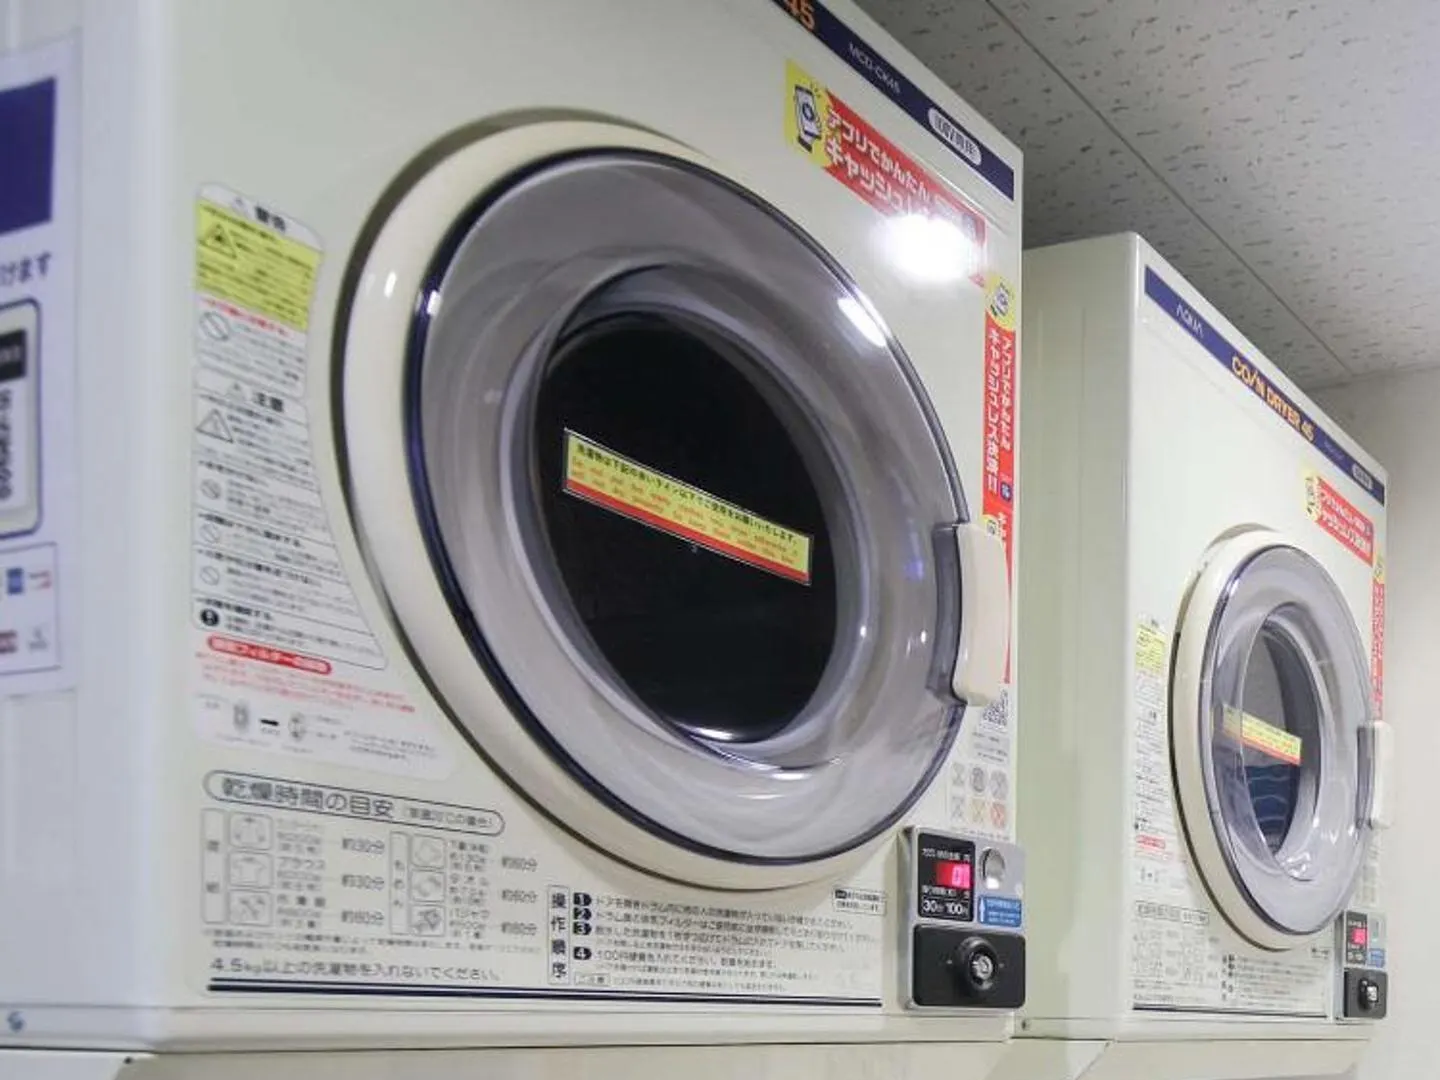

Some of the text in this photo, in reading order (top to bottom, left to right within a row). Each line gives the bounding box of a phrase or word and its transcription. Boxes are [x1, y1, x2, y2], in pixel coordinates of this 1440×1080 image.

[222, 778, 394, 819] 乾燥時間の目安
